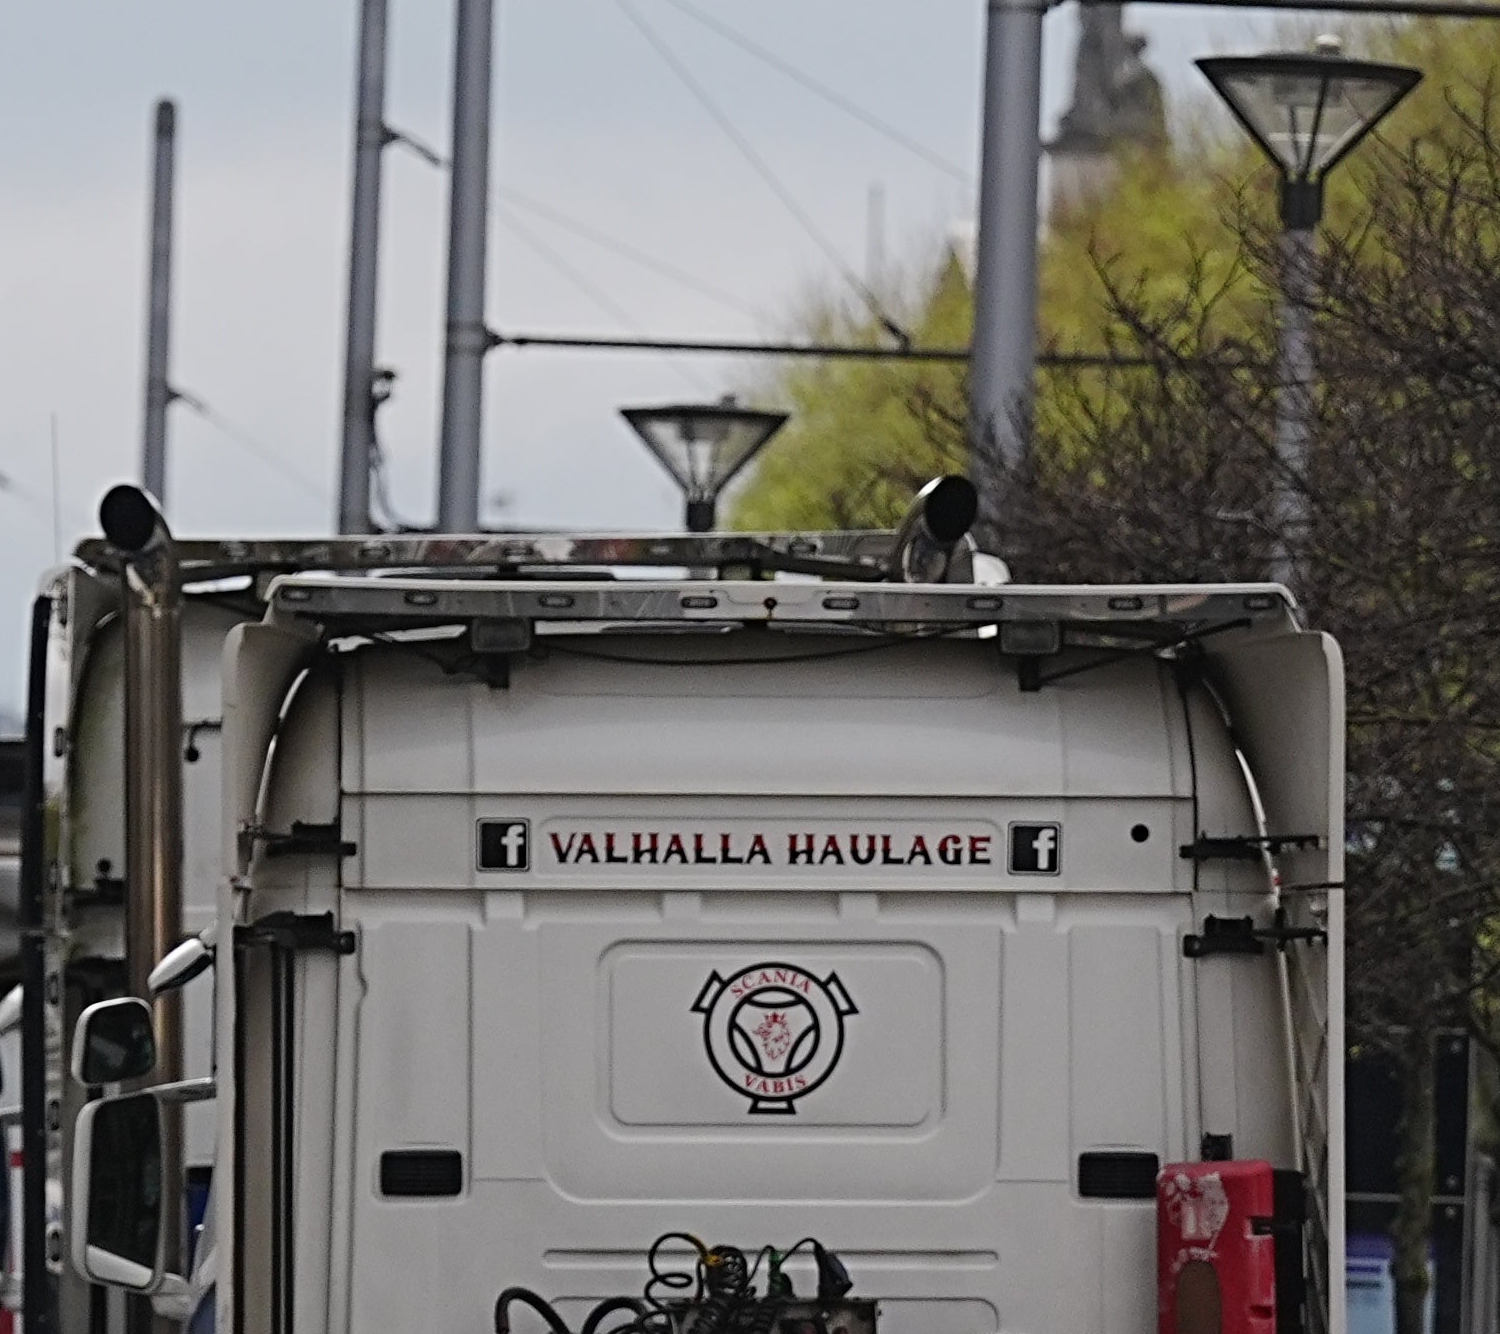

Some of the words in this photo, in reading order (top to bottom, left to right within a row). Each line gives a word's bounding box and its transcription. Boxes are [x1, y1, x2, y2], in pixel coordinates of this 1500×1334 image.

[549, 831, 771, 865] VALHALLA
[787, 834, 993, 866] HAULAGE
[729, 968, 812, 1000] SCANIA
[744, 1071, 808, 1095] VABIS
